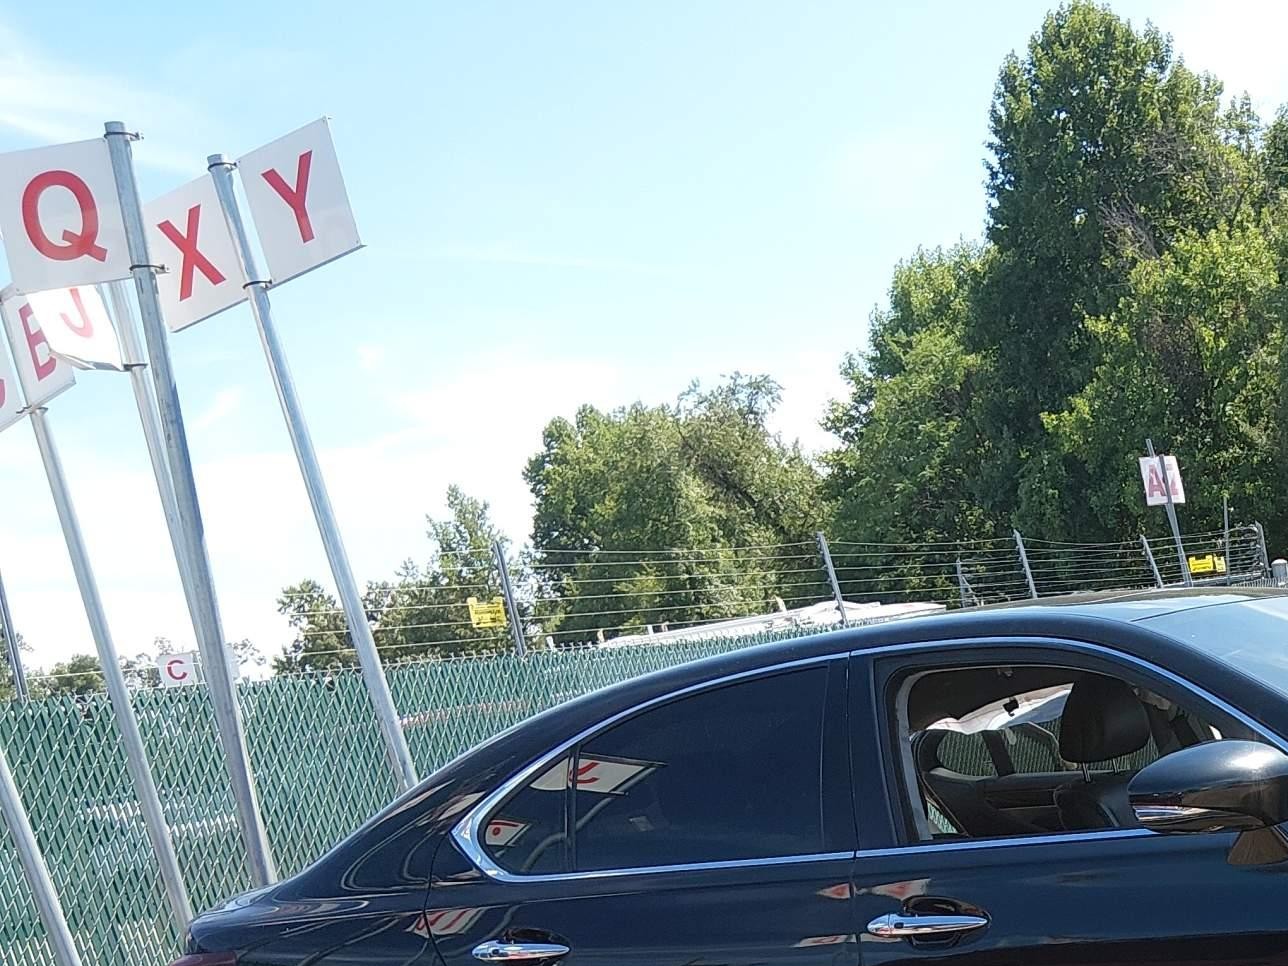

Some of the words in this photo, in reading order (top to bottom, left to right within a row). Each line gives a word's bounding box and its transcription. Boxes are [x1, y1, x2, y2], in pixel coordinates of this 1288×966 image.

[21, 169, 108, 263] Q
[261, 150, 314, 244] Y
[156, 204, 227, 302] X
[166, 659, 188, 681] C
